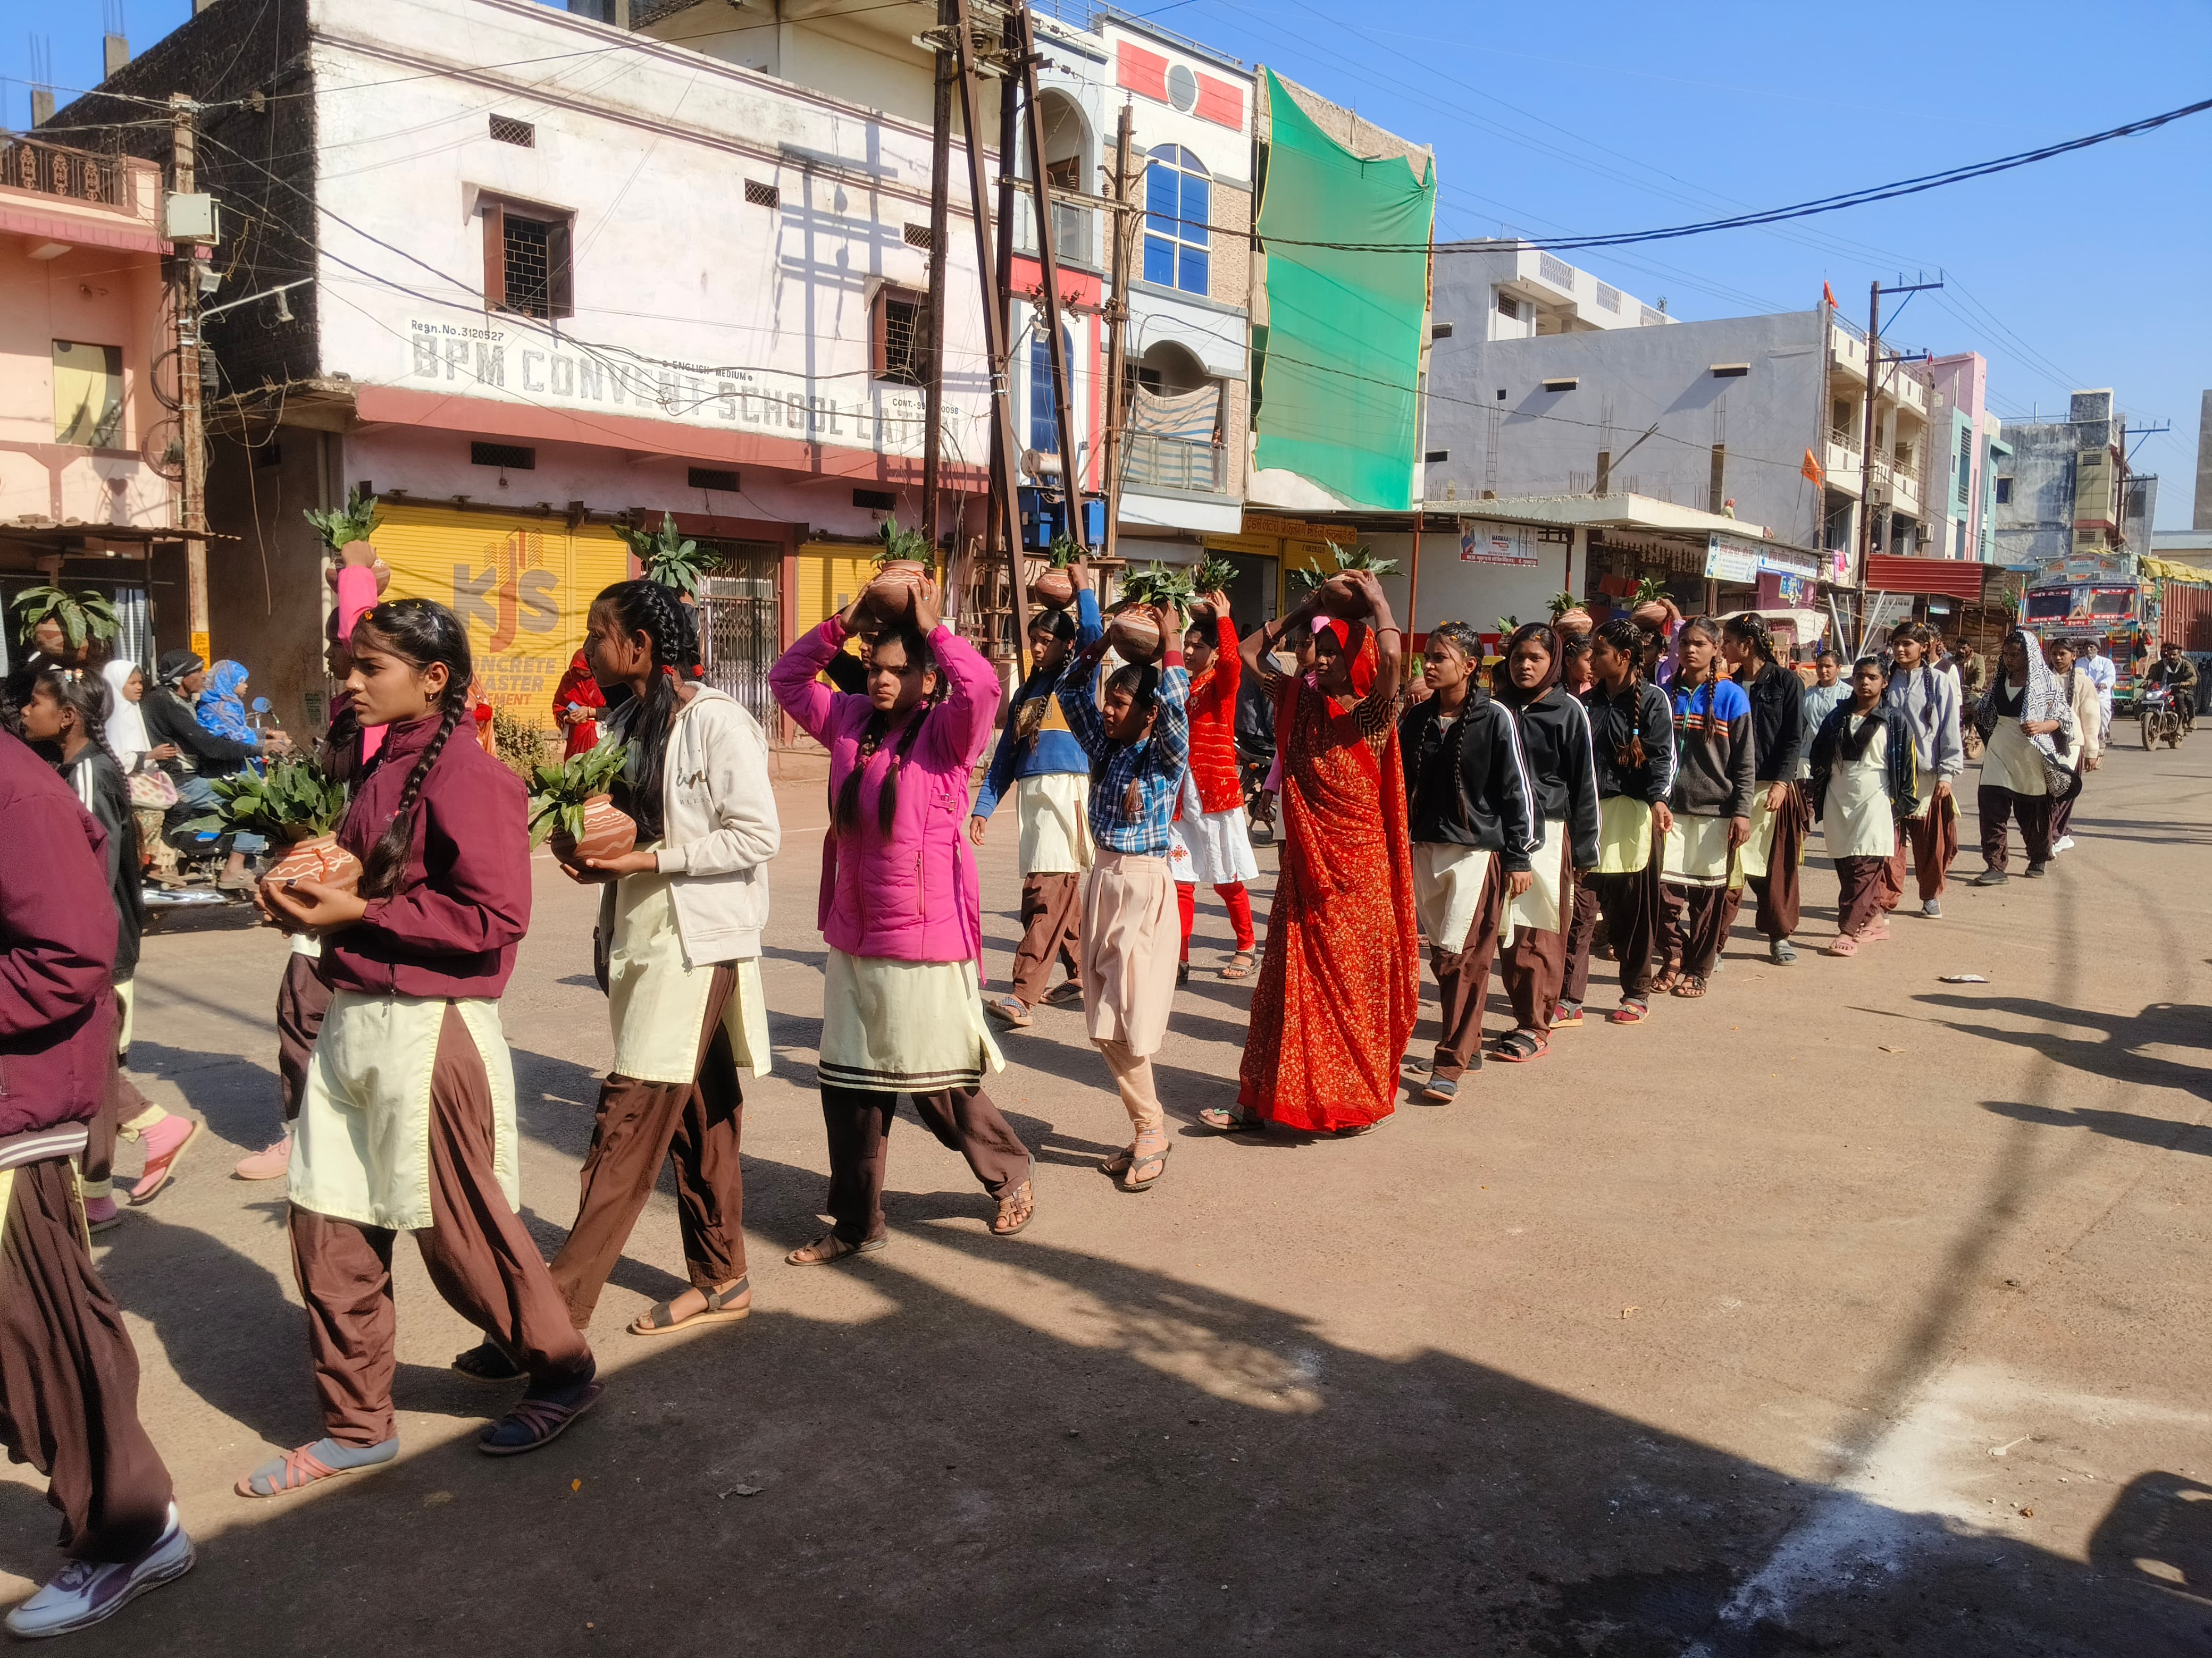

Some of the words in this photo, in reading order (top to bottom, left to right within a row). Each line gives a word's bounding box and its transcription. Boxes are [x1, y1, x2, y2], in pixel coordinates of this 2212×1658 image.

[673, 360, 709, 375] ENGLISH
[716, 369, 746, 381] MEDIUM
[413, 333, 505, 387] BPM
[522, 349, 705, 416] CONVENT
[718, 381, 844, 435] SCHOOL
[453, 541, 560, 653] KJS
[472, 655, 557, 674] NCRETE
[479, 674, 544, 692] ASTER
[488, 693, 532, 706] EMENT
